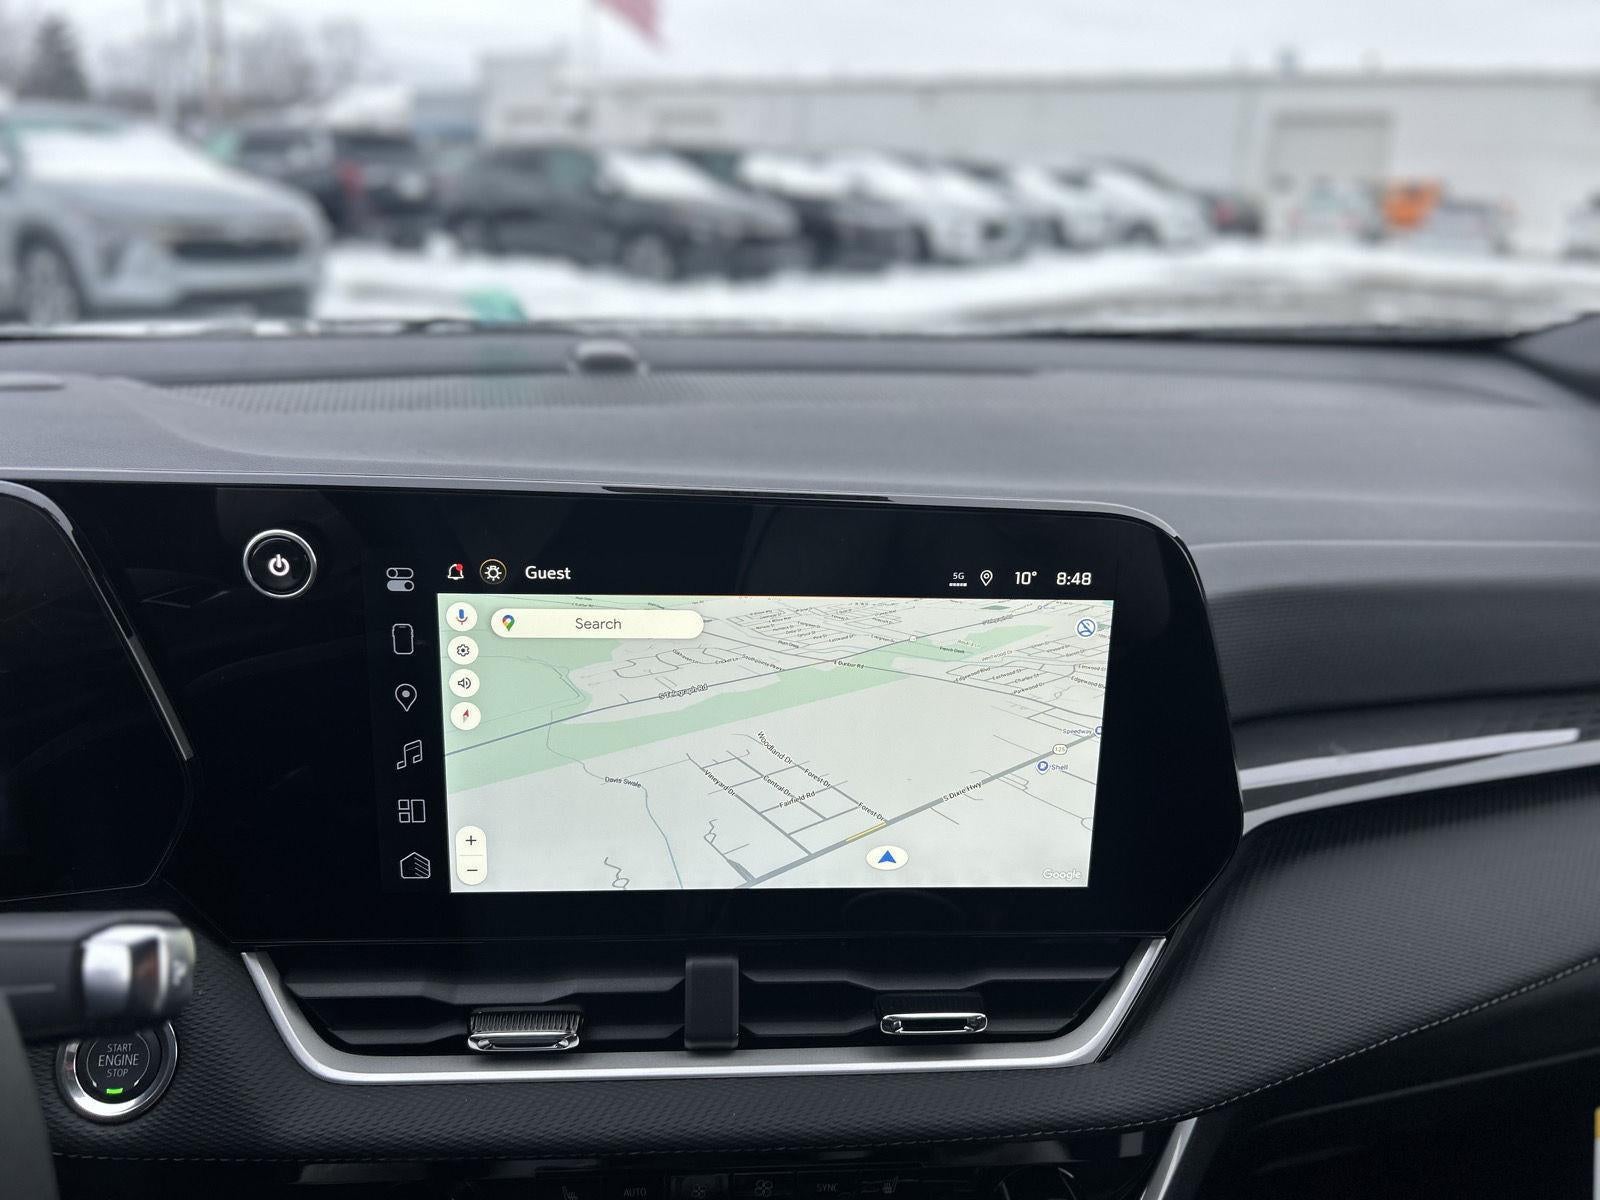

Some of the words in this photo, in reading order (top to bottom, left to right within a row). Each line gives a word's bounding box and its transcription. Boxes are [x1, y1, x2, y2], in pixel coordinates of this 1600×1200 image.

[525, 566, 571, 580] Guest
[952, 572, 965, 580] 5G
[1014, 571, 1038, 586] 10°
[1056, 572, 1092, 586] 8:48
[575, 617, 622, 631] Search
[664, 686, 698, 699] Telegraph
[697, 683, 708, 692] Rd
[1062, 728, 1092, 736] Speedway
[757, 730, 785, 761] Woodland
[604, 775, 622, 785] Davis
[623, 777, 642, 789] Swale
[704, 769, 730, 793] Vineyard
[726, 786, 736, 797] Dr
[804, 768, 823, 785] Forest
[822, 779, 832, 788] Dr
[763, 775, 785, 793] Central
[783, 787, 792, 797] Dr
[948, 788, 966, 800] Dixie
[966, 781, 982, 793] Hwy
[778, 794, 806, 809] Fairfield
[805, 790, 816, 800] Rd
[858, 801, 878, 818] Forest
[876, 812, 885, 822] Dr
[1042, 868, 1081, 882] Google
[107, 1043, 133, 1053] START
[98, 1053, 140, 1067] ENGINE
[107, 1068, 129, 1078] STOP
[623, 1187, 648, 1198] AUTO
[816, 1183, 840, 1193] SYNC
